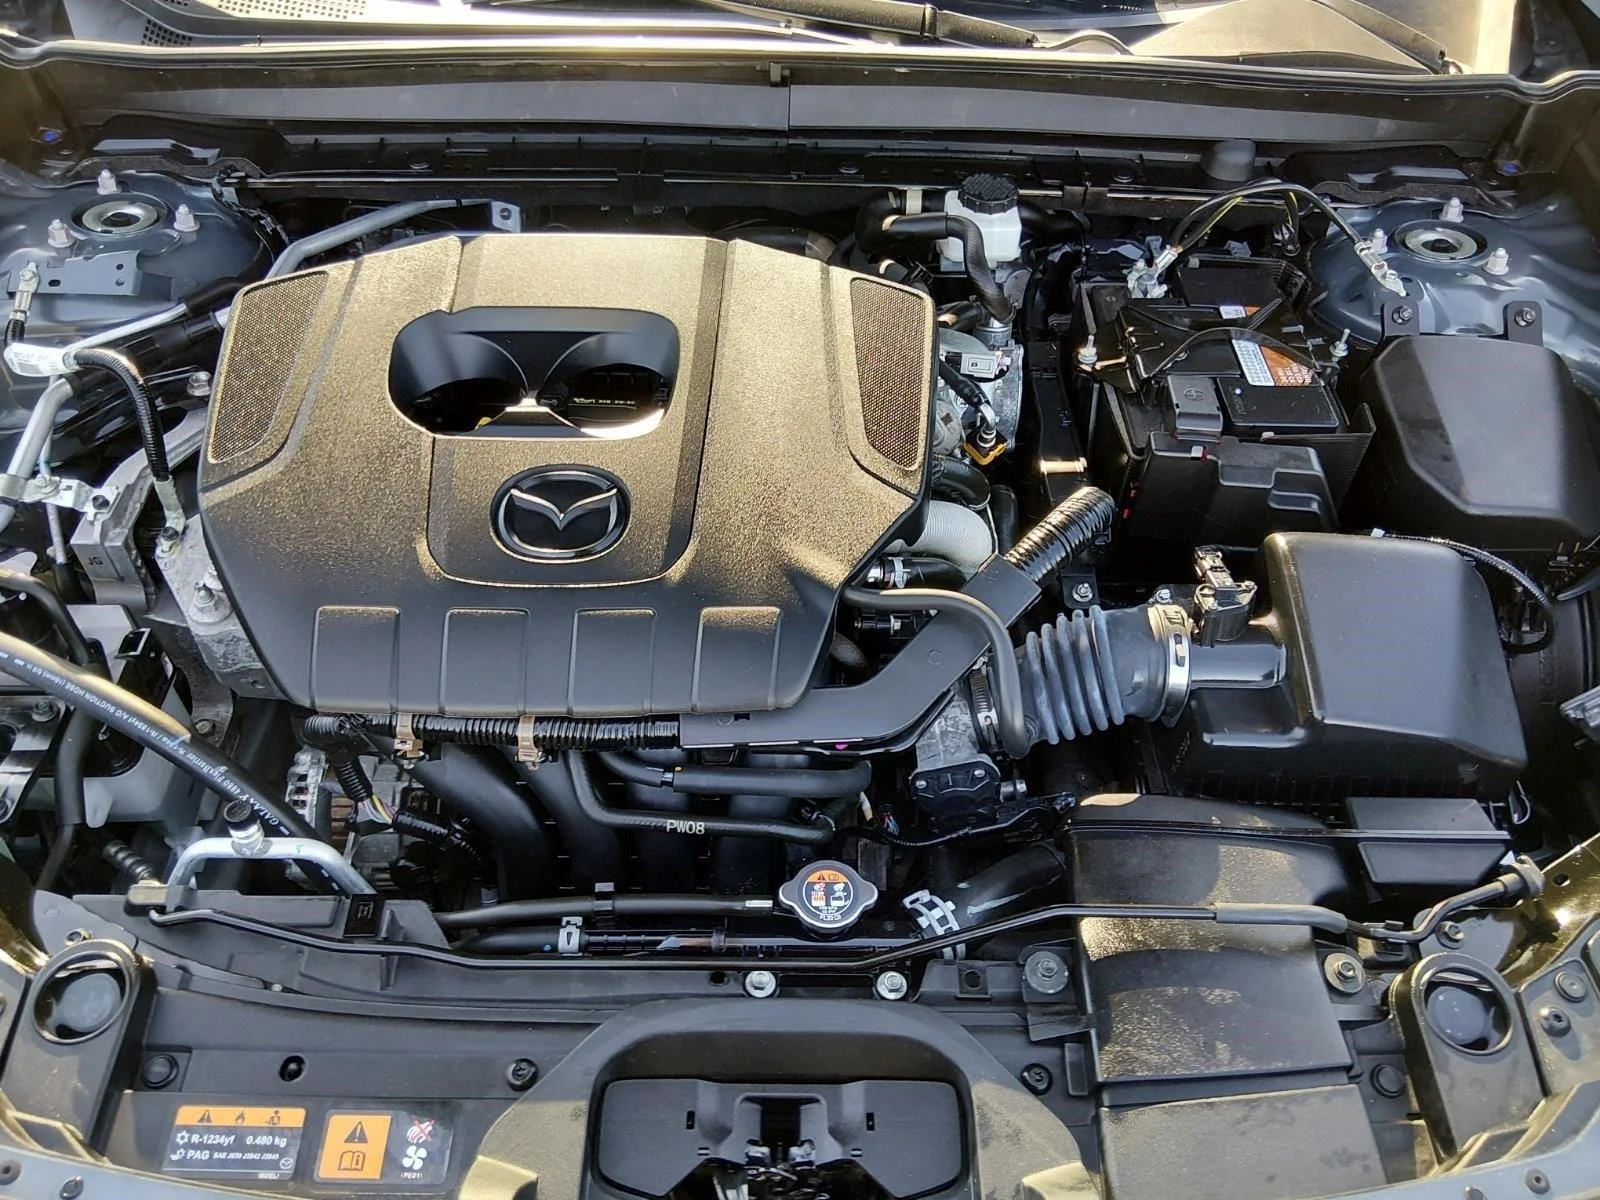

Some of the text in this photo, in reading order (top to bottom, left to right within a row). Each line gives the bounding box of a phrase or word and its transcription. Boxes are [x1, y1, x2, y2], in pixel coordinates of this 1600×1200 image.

[64, 681, 86, 697] HOSE
[84, 692, 116, 713] SUCTION
[666, 819, 705, 835] PW08
[190, 1134, 288, 1148] R-1234yf 0.480 kg
[186, 1150, 211, 1160] PAG
[212, 1152, 228, 1160] SAE
